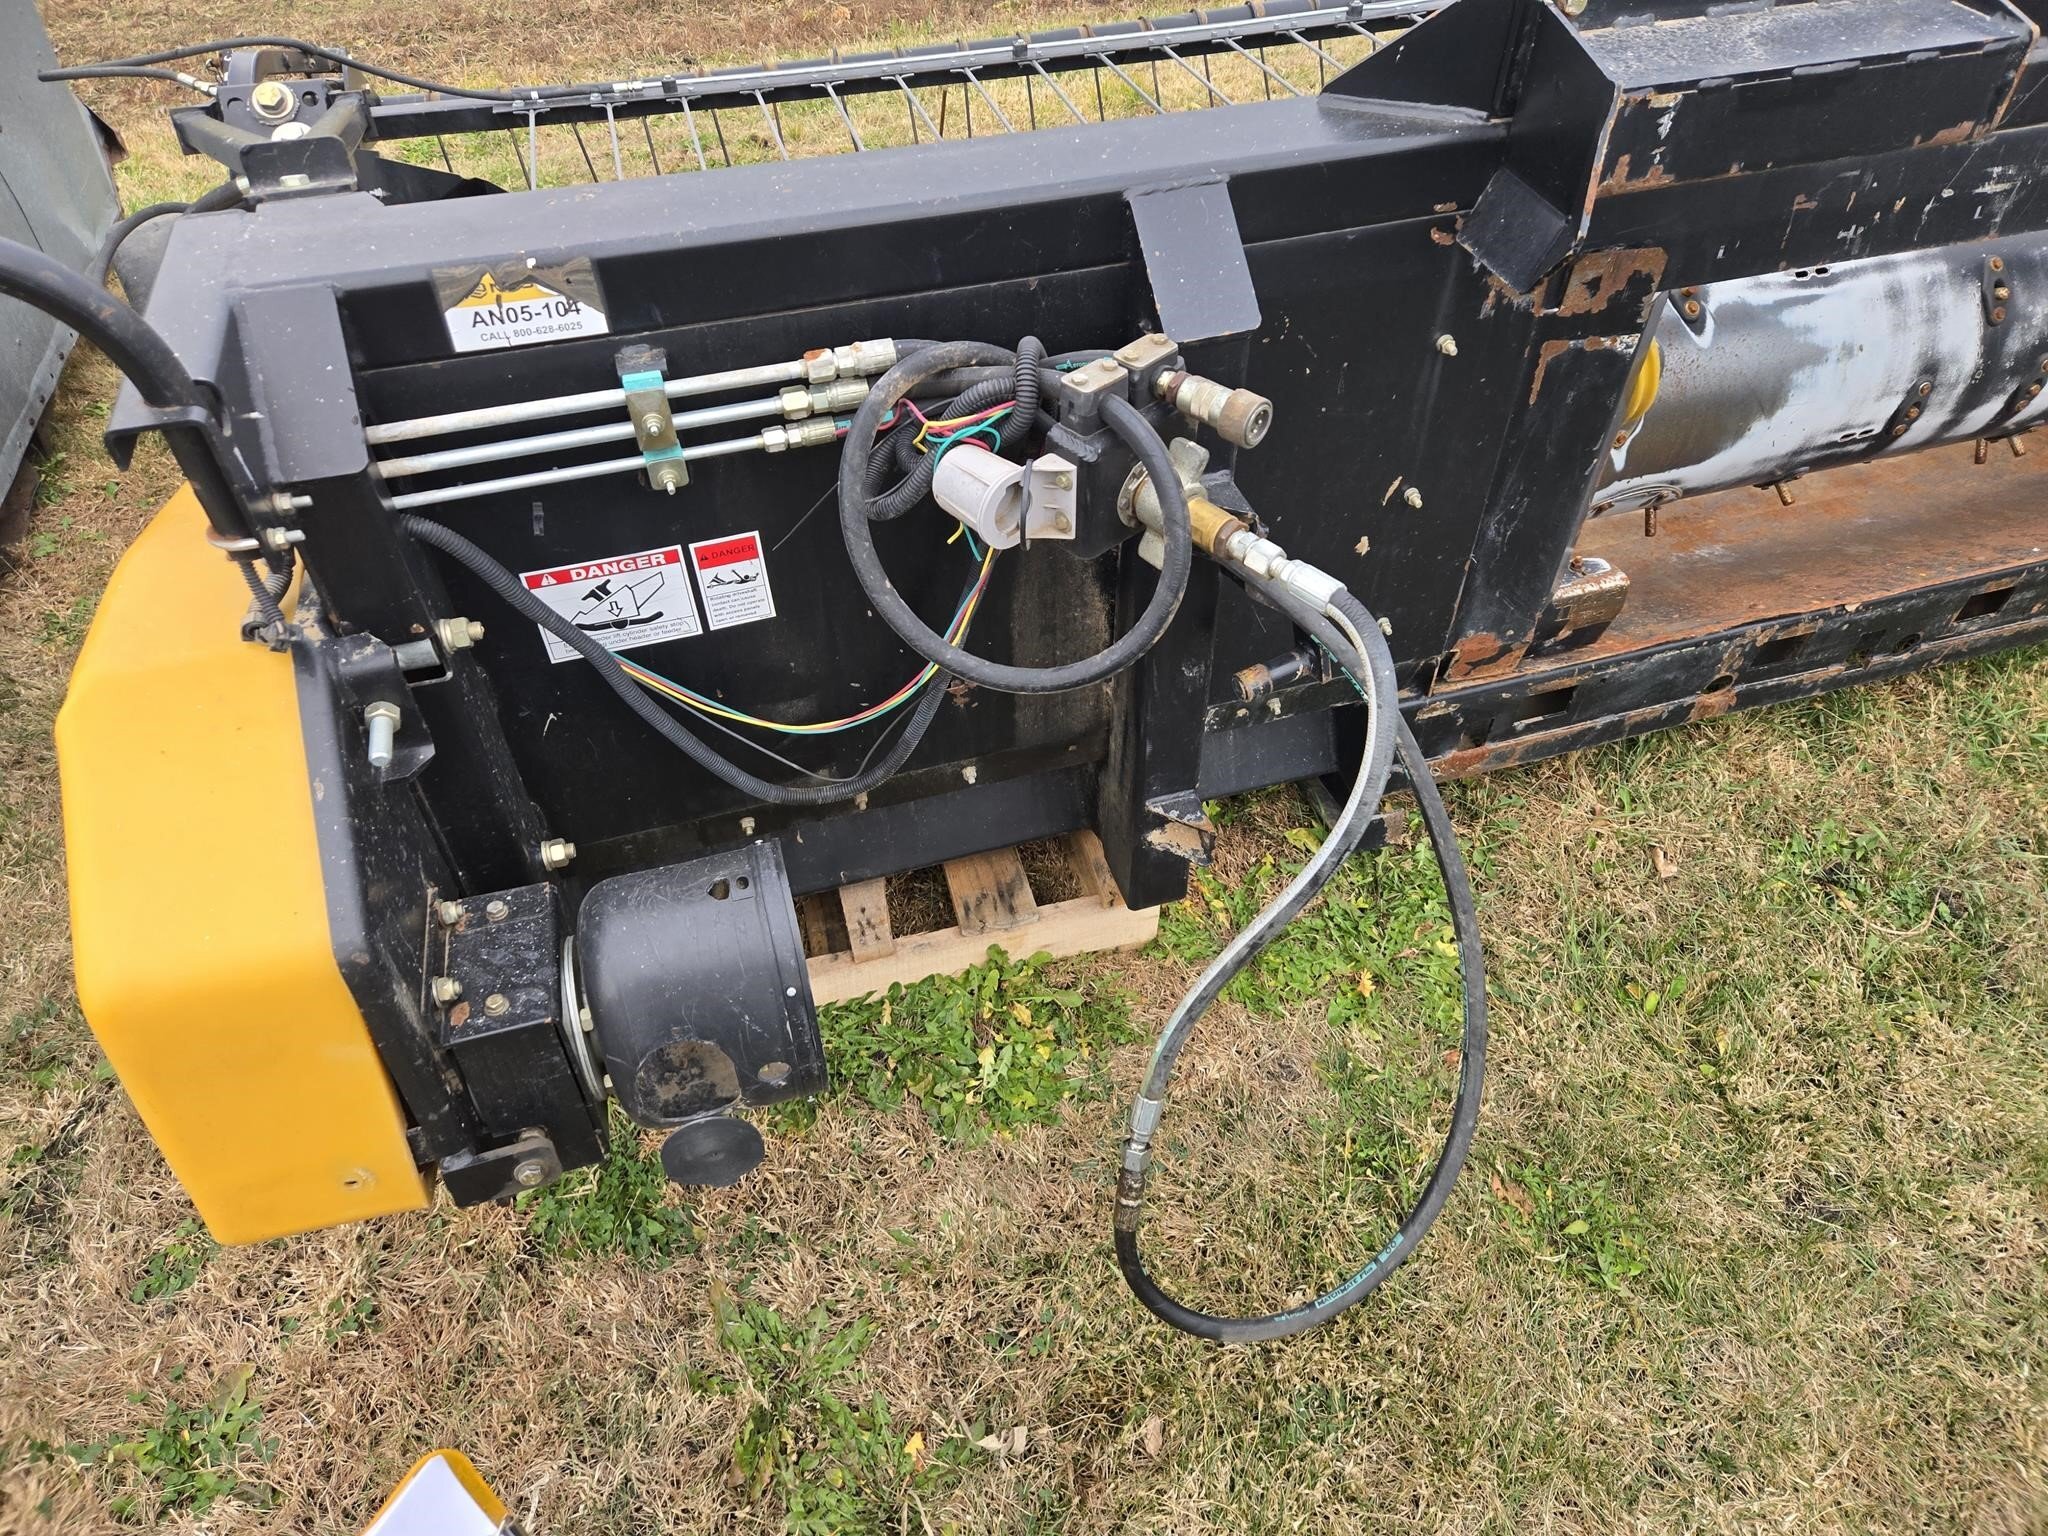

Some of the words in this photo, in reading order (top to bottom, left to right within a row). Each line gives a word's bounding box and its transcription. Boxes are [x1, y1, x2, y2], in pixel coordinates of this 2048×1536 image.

[472, 300, 582, 329] AN05-104
[480, 331, 511, 342] CALL
[513, 321, 584, 338] 800-628-6025
[711, 544, 755, 559] DANGER
[569, 553, 667, 581] DANGER
